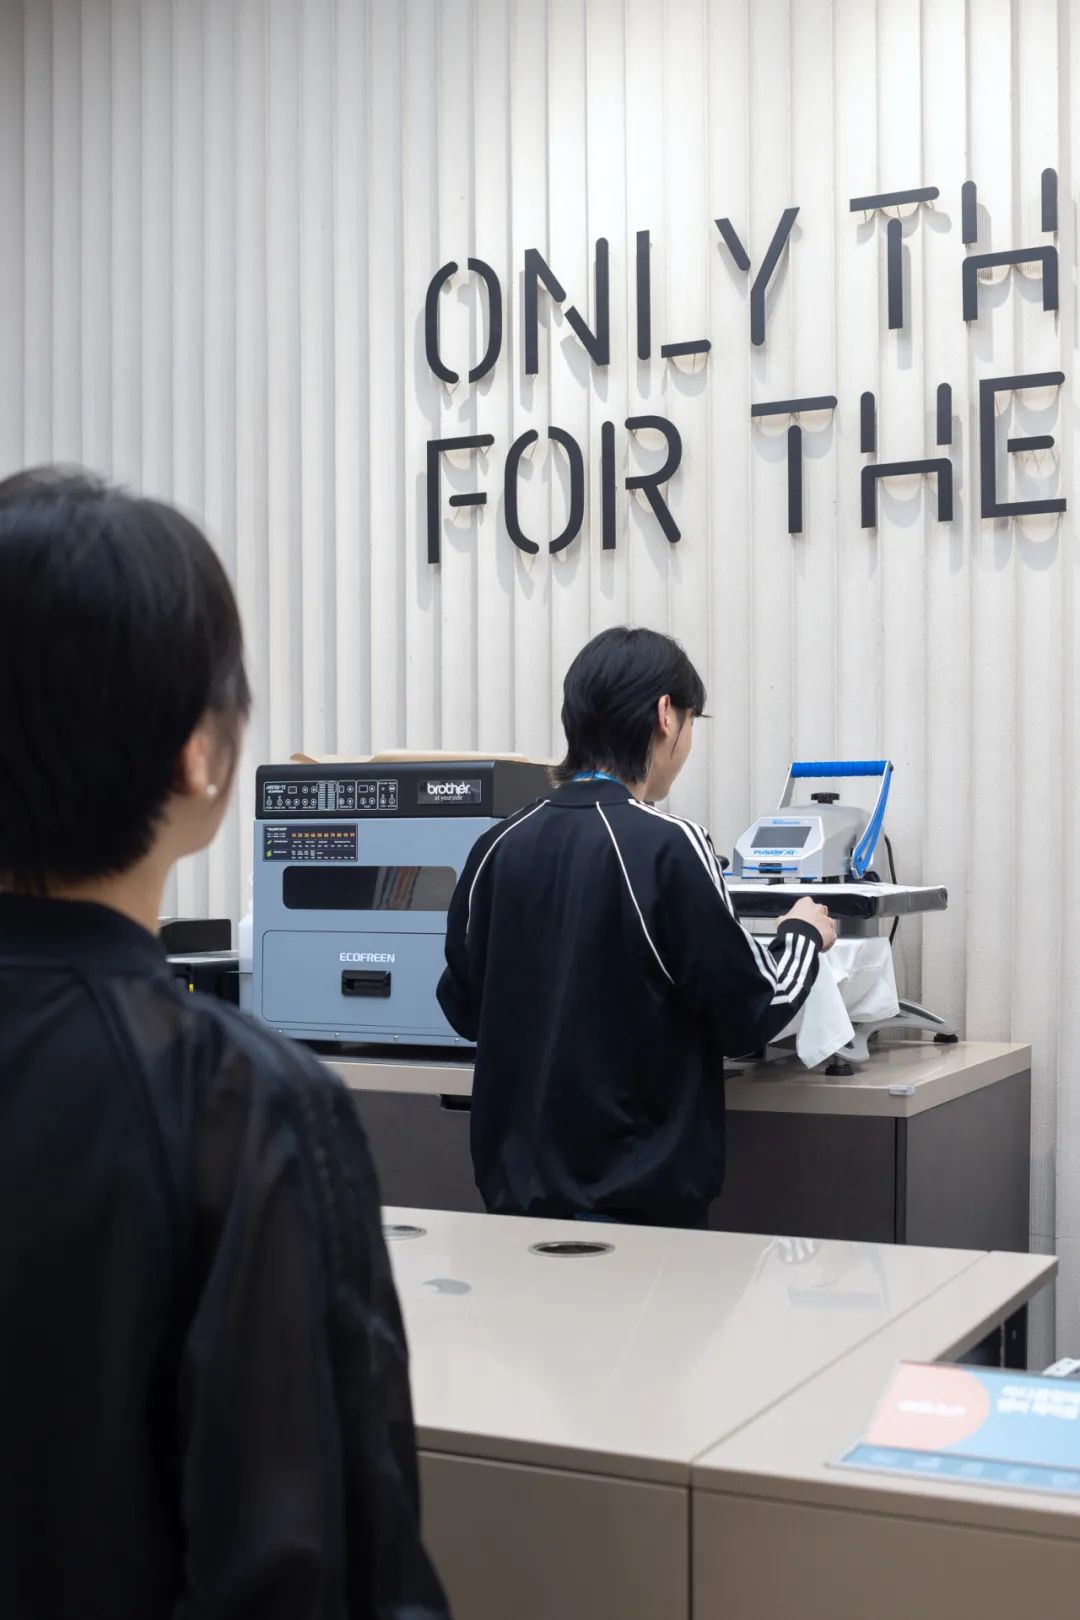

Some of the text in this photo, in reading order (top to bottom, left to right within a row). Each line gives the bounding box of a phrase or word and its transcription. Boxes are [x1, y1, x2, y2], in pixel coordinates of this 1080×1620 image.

[425, 168, 1058, 383] ONLY TH
[427, 371, 1067, 564] FOR THE
[427, 781, 471, 795] brother
[339, 952, 395, 963] ECOFREEN
